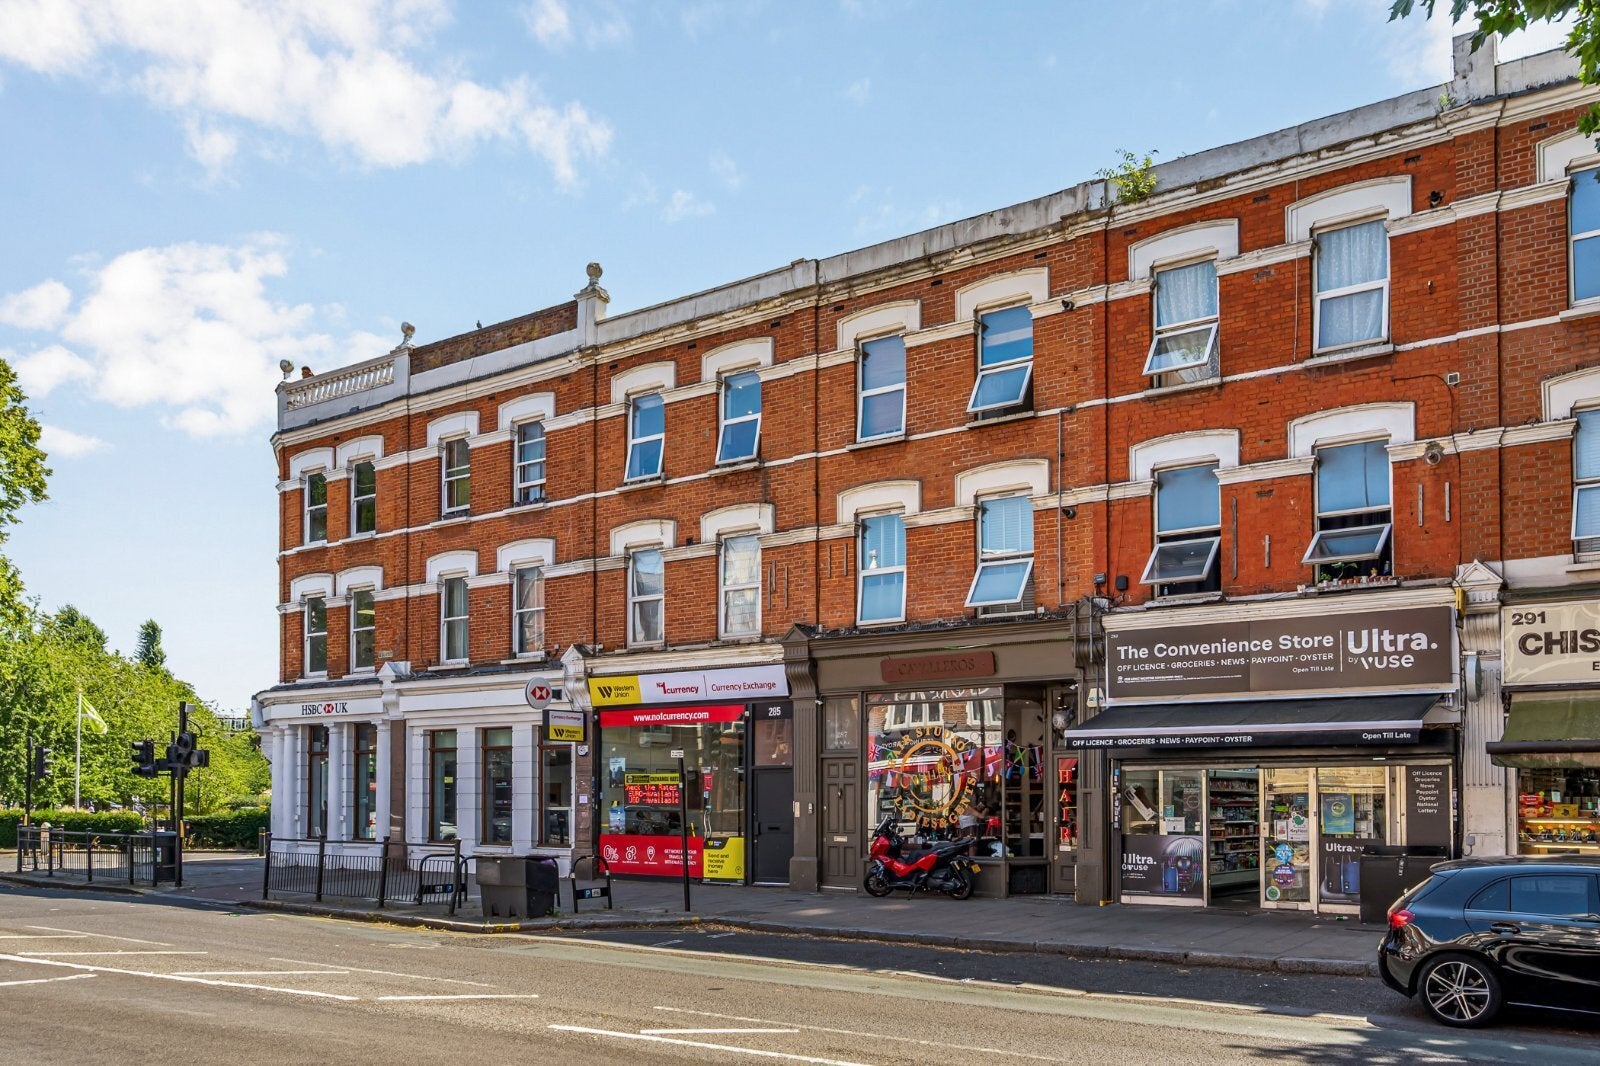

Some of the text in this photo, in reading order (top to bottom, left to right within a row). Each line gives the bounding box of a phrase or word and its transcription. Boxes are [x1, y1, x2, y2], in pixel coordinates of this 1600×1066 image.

[1512, 611, 1546, 626] 291
[1117, 635, 1334, 660] The Convenience Store
[1348, 628, 1438, 654] Ultra.
[1518, 629, 1600, 656] CHIS
[1133, 662, 1166, 671] LICENCE
[1171, 660, 1215, 669] GROCERIES
[1221, 658, 1245, 666] NEWS
[1252, 655, 1294, 664] PAYPOINT
[1300, 652, 1334, 662] OYSTER
[712, 682, 776, 692] Currency Exchange
[302, 702, 348, 715] HSBC UK
[768, 706, 781, 716] 285
[1058, 769, 1072, 841] HAIR
[1326, 843, 1356, 852] Ultra.
